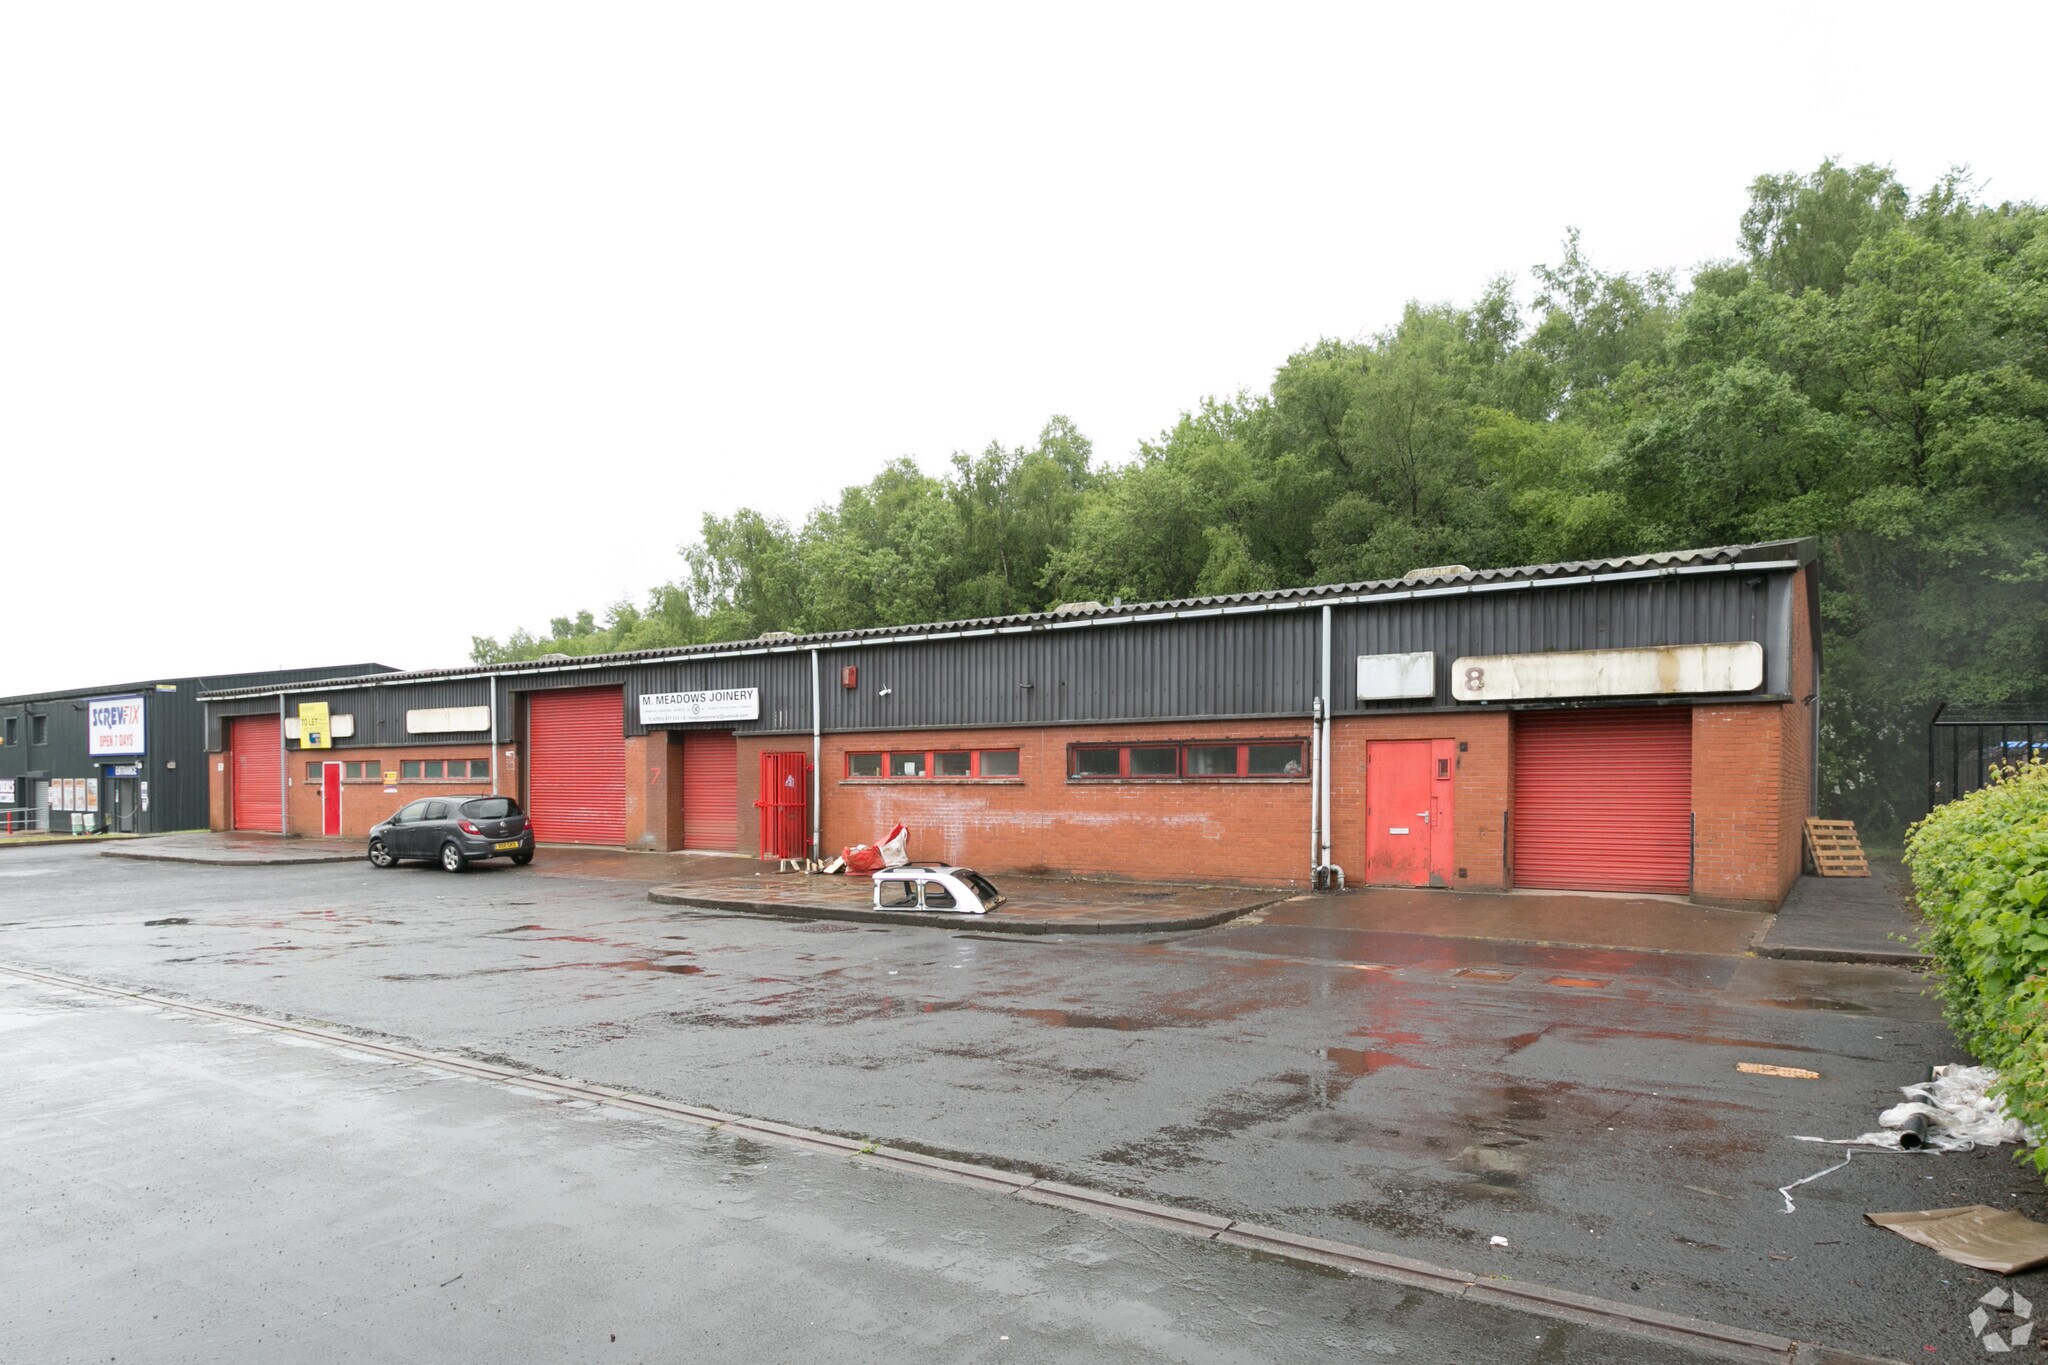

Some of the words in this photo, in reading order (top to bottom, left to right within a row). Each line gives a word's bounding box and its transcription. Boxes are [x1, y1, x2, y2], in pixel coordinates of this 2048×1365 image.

[1464, 667, 1484, 691] 8
[643, 696, 653, 706] M.
[656, 692, 706, 705] MEADOWS
[709, 690, 753, 702] JOINERY
[92, 704, 140, 730] SCREWFIX
[301, 718, 308, 726] TO
[309, 718, 318, 726] LET
[100, 735, 112, 747] OPEN
[114, 734, 118, 746] 7
[119, 734, 133, 746] DAYS
[651, 768, 662, 784] 7
